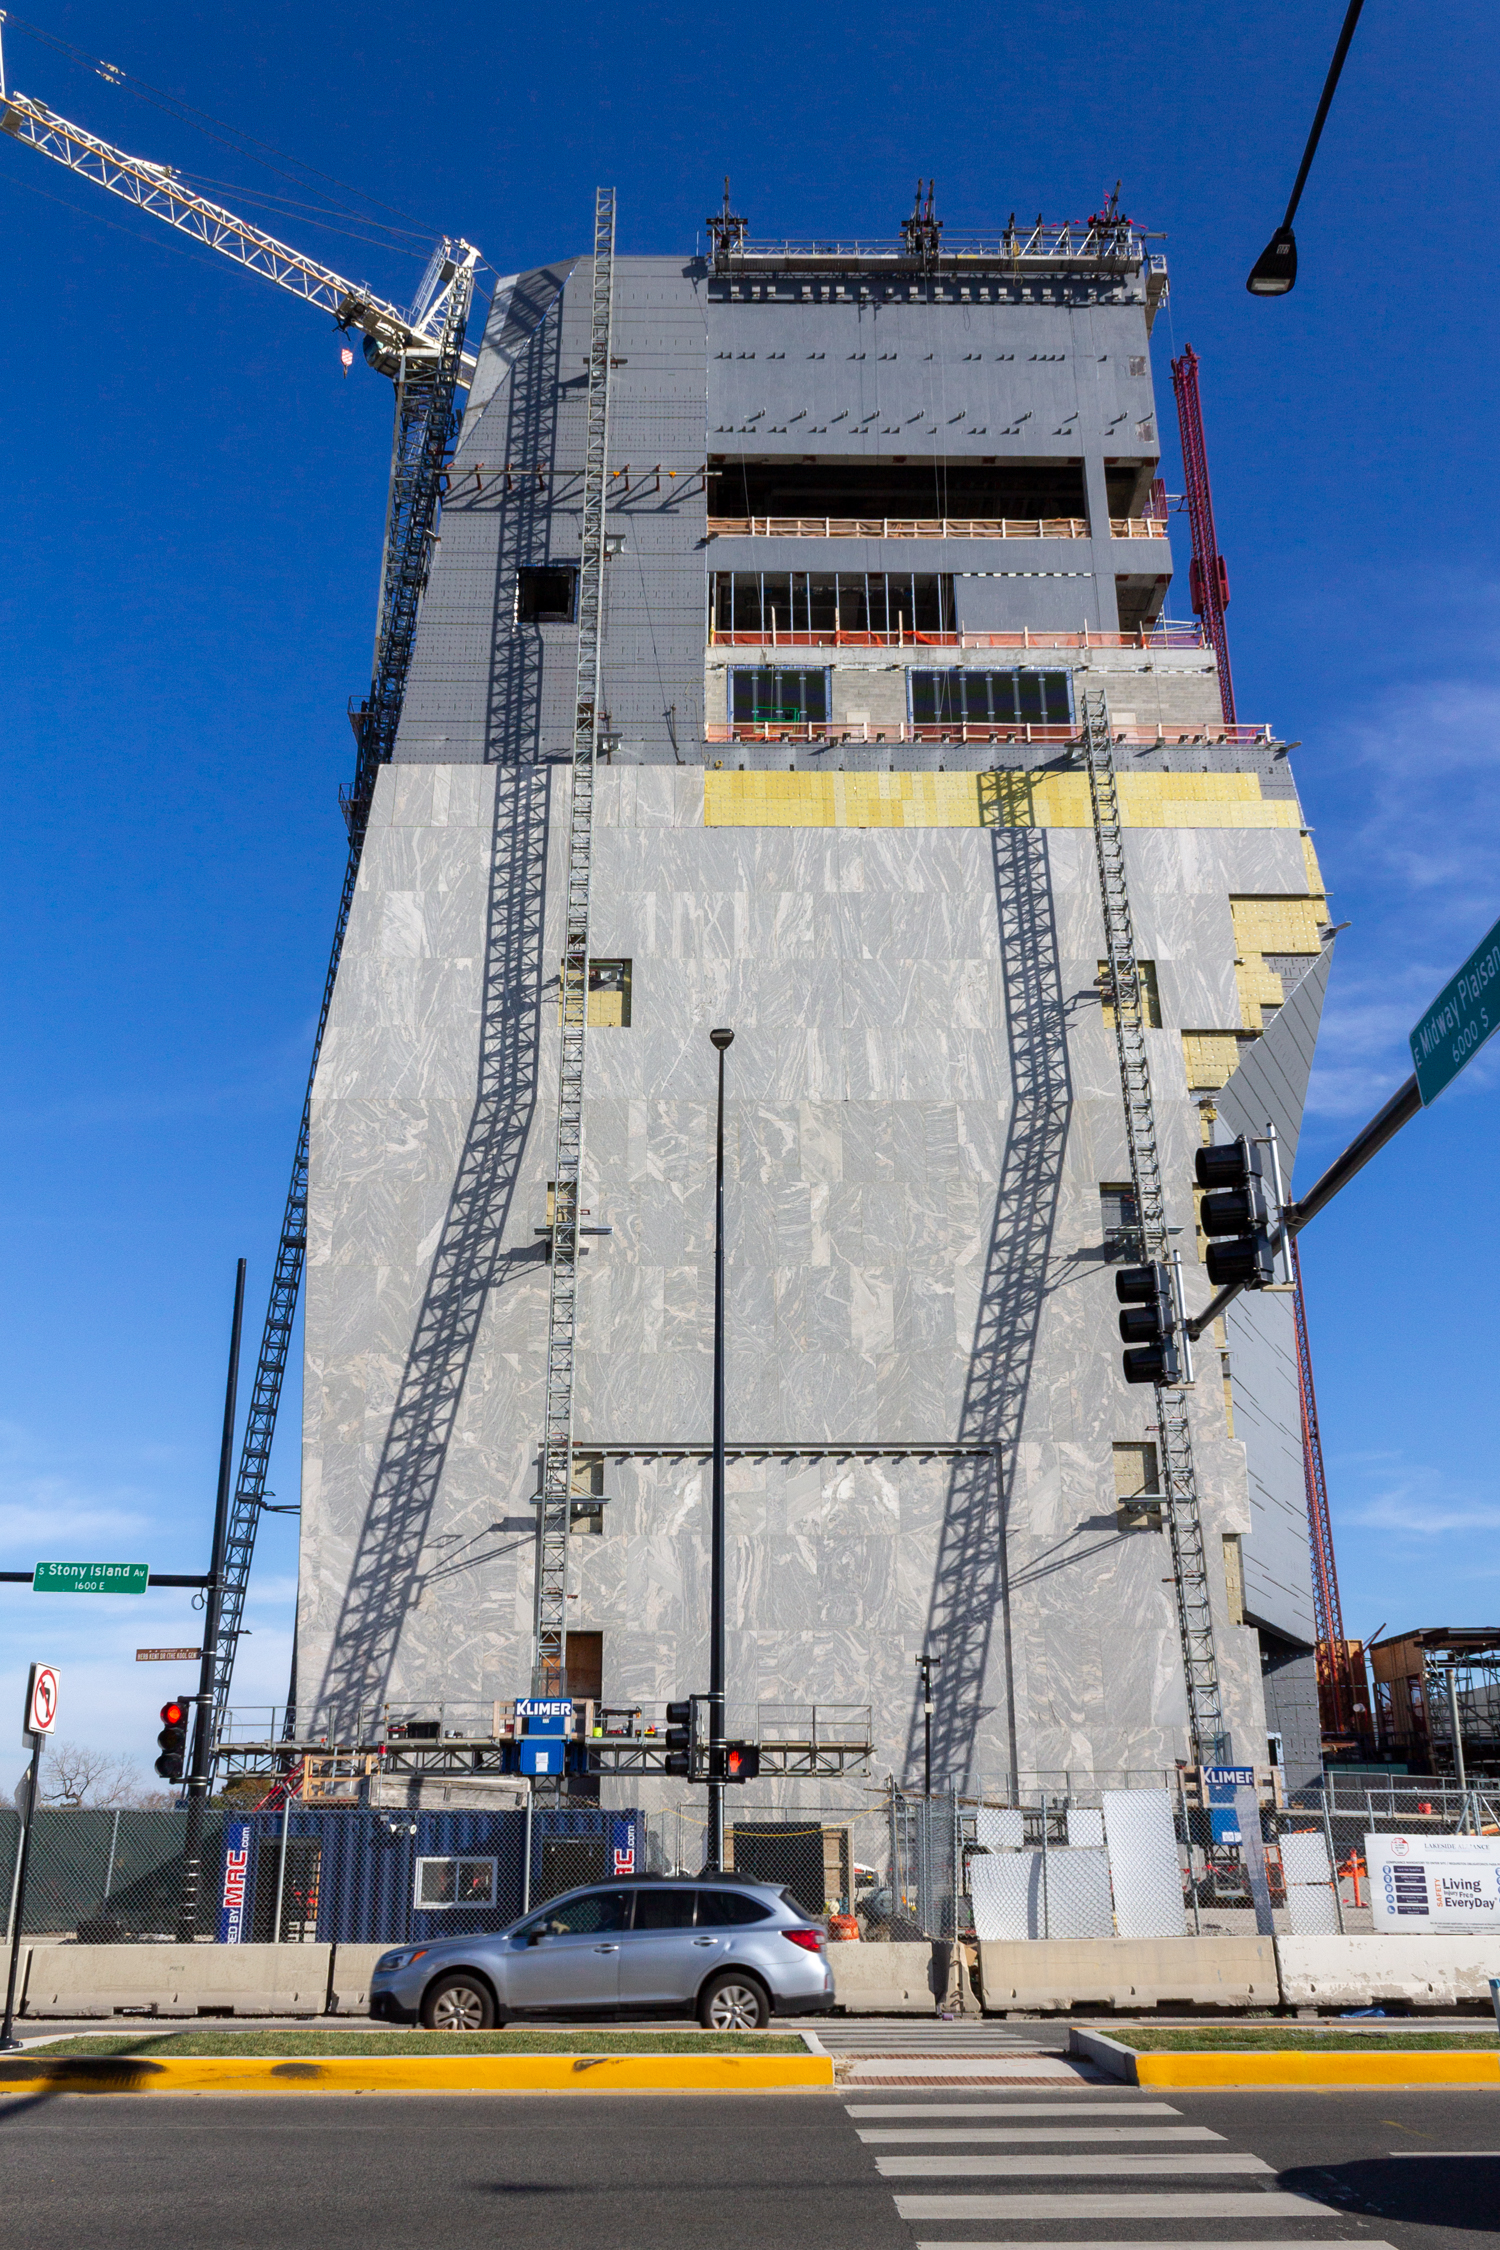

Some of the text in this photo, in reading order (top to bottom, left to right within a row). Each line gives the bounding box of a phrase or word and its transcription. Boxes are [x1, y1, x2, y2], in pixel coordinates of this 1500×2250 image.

[1414, 1047, 1422, 1066] E
[1419, 996, 1461, 1058] Midway
[1452, 1007, 1489, 1062] 6000 S
[39, 1563, 145, 1579] S Stony Island Av
[74, 1581, 105, 1590] 1600 E
[516, 1698, 571, 1715] KLIMER
[1204, 1767, 1253, 1784] KLIMER
[1434, 1878, 1443, 1907] SAFETY
[1442, 1878, 1482, 1893] Living
[1445, 1897, 1495, 1910] EveryDay
[229, 1908, 239, 1923] BY
